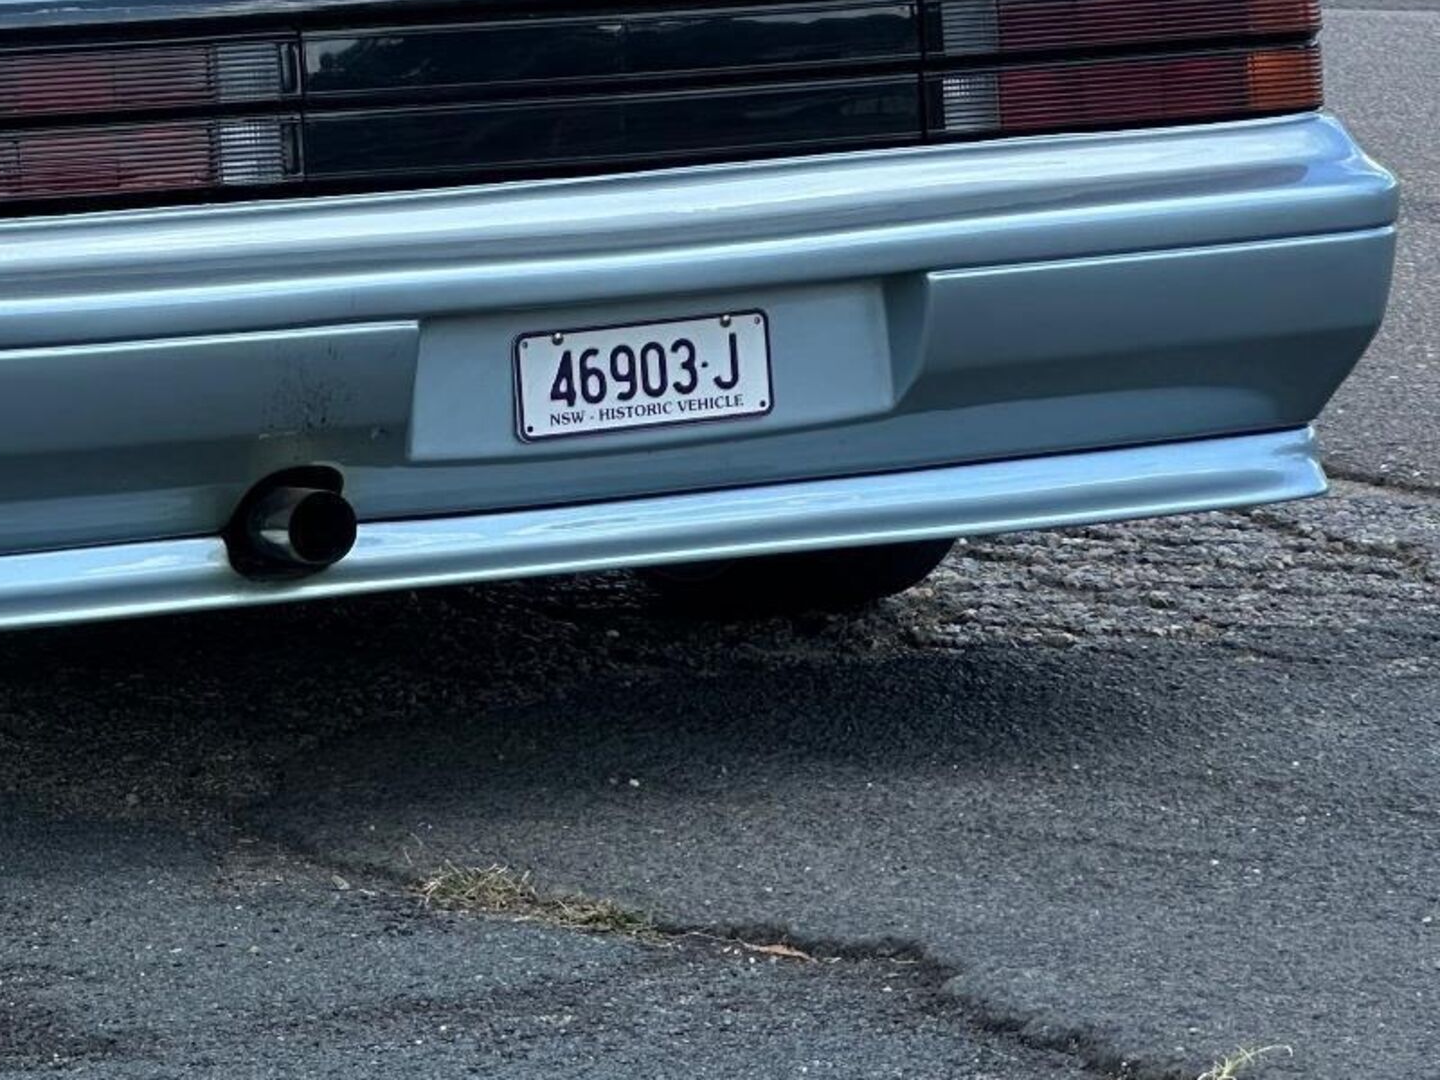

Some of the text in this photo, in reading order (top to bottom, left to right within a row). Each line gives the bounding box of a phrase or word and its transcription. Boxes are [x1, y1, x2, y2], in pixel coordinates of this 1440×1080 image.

[550, 410, 586, 427] NSW
[599, 401, 673, 422] HISTORIC
[676, 393, 745, 412] VEHICLE
